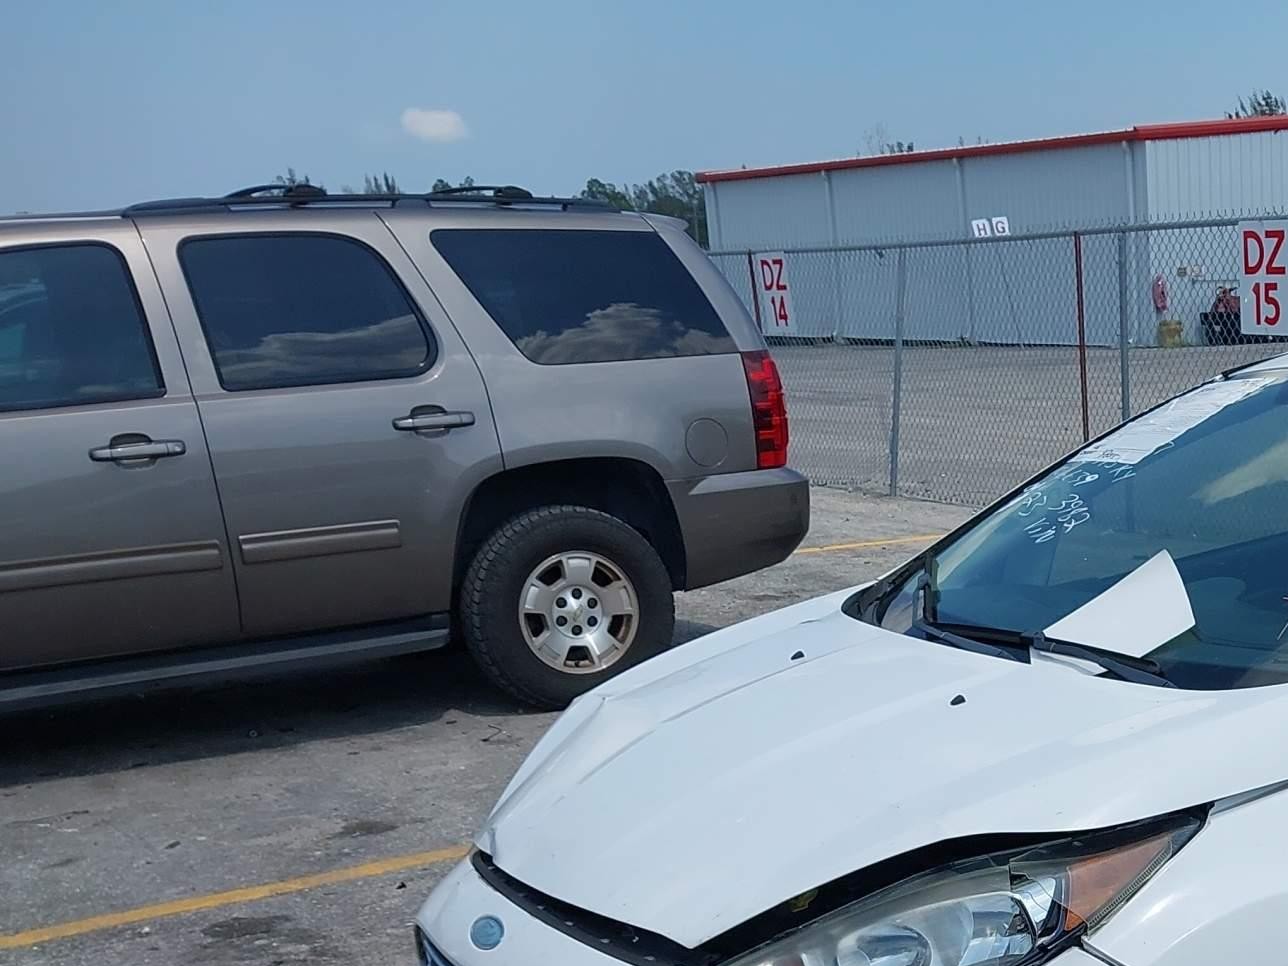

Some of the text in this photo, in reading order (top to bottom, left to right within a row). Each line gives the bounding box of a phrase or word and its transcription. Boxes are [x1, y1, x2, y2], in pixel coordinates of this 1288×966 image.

[976, 220, 1006, 237] H G
[1243, 230, 1286, 275] DZ
[759, 259, 788, 291] DZ
[771, 296, 788, 327] 14
[1252, 282, 1281, 326] 15
